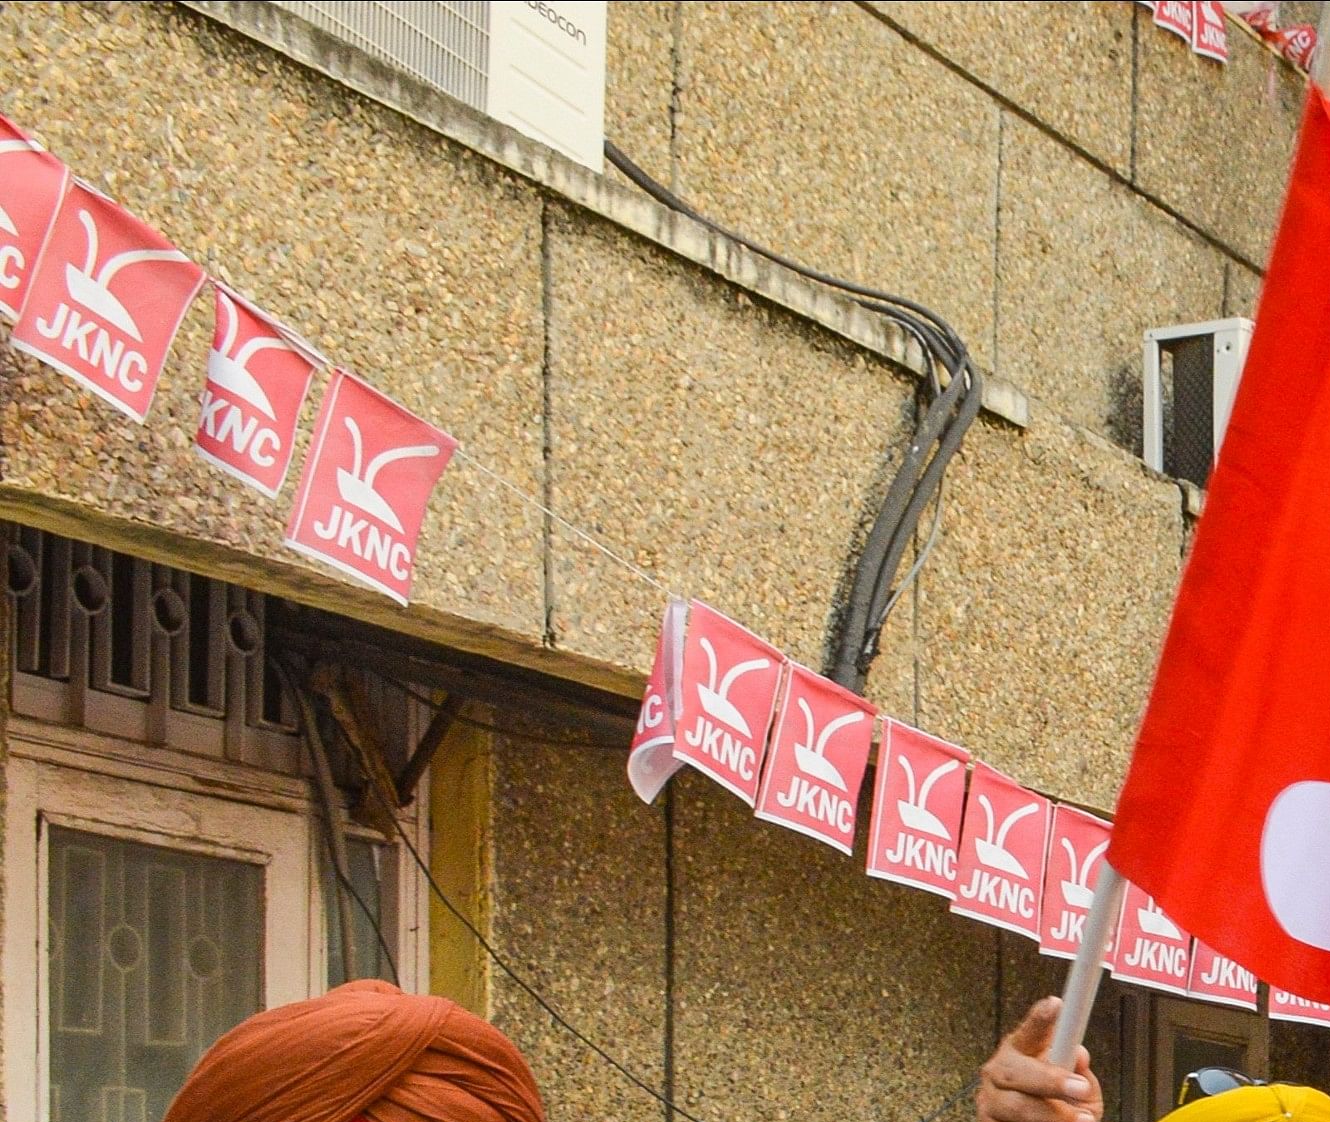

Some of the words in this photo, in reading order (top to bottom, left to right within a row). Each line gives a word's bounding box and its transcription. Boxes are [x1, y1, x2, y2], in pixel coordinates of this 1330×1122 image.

[36, 303, 148, 392] JKNC
[200, 391, 281, 467] KNC
[314, 506, 411, 581] JKNC
[684, 716, 756, 781] JKNC
[777, 777, 853, 834] JKNC
[885, 832, 958, 881] JKNC
[959, 870, 1035, 919] JKNC
[1124, 937, 1187, 978] JKNC
